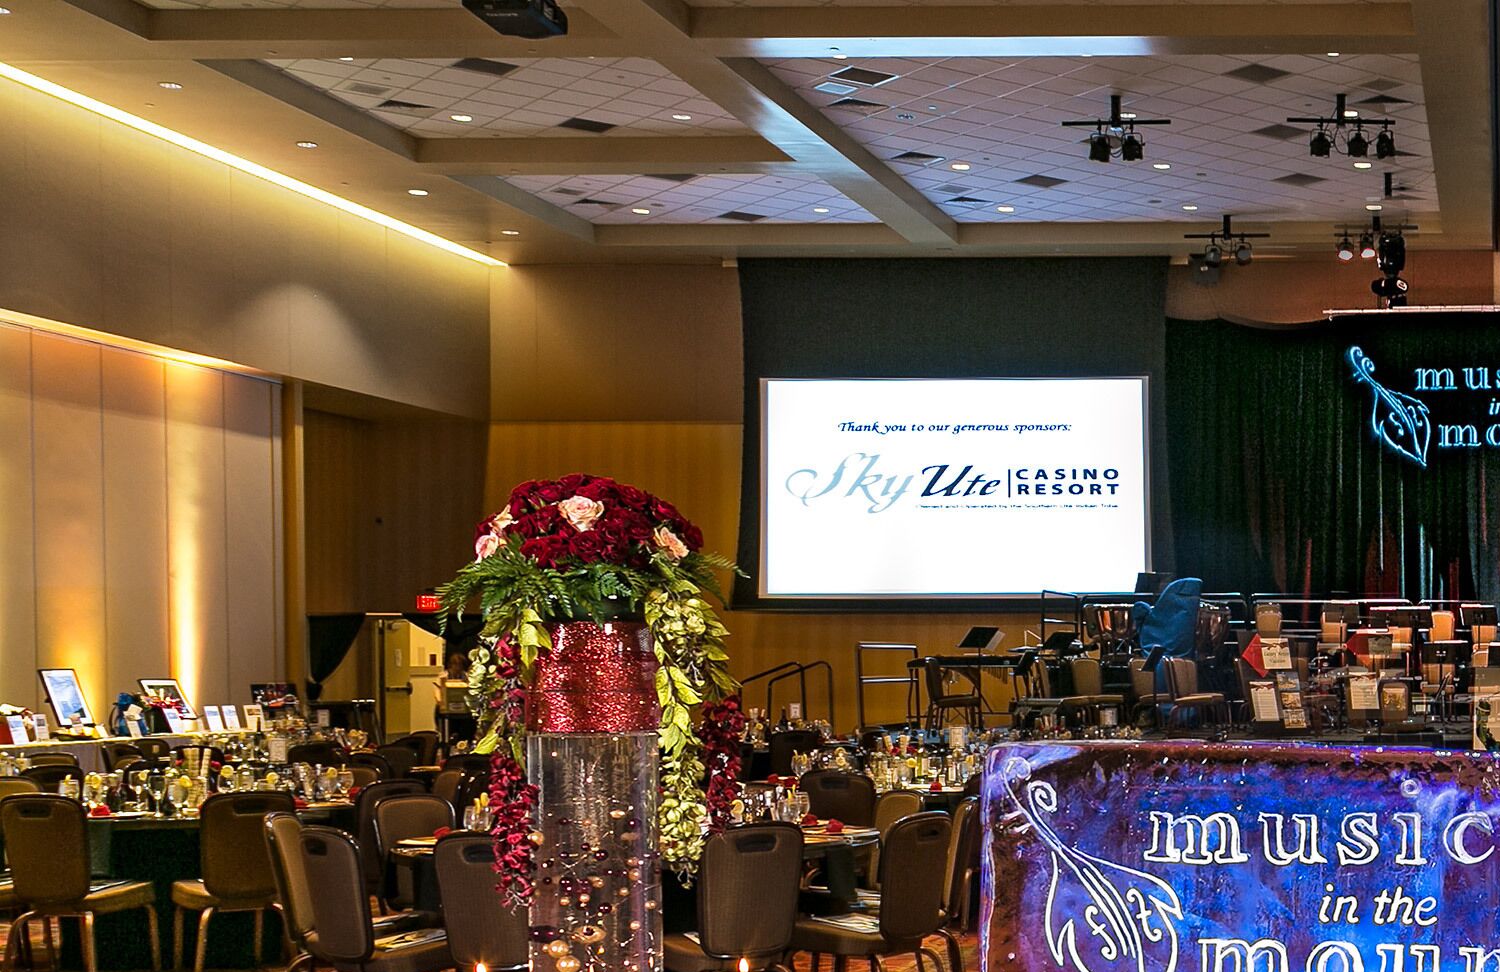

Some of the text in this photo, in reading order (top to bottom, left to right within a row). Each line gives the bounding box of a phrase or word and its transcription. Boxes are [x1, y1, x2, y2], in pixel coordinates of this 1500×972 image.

[838, 421, 1072, 435] Thank you to our generous sponsors:
[785, 452, 1001, 514] Sky Ute
[1015, 468, 1119, 480] CASINO
[1017, 483, 1120, 496] RESORT
[1144, 778, 1497, 866] music
[1318, 882, 1439, 926] in the
